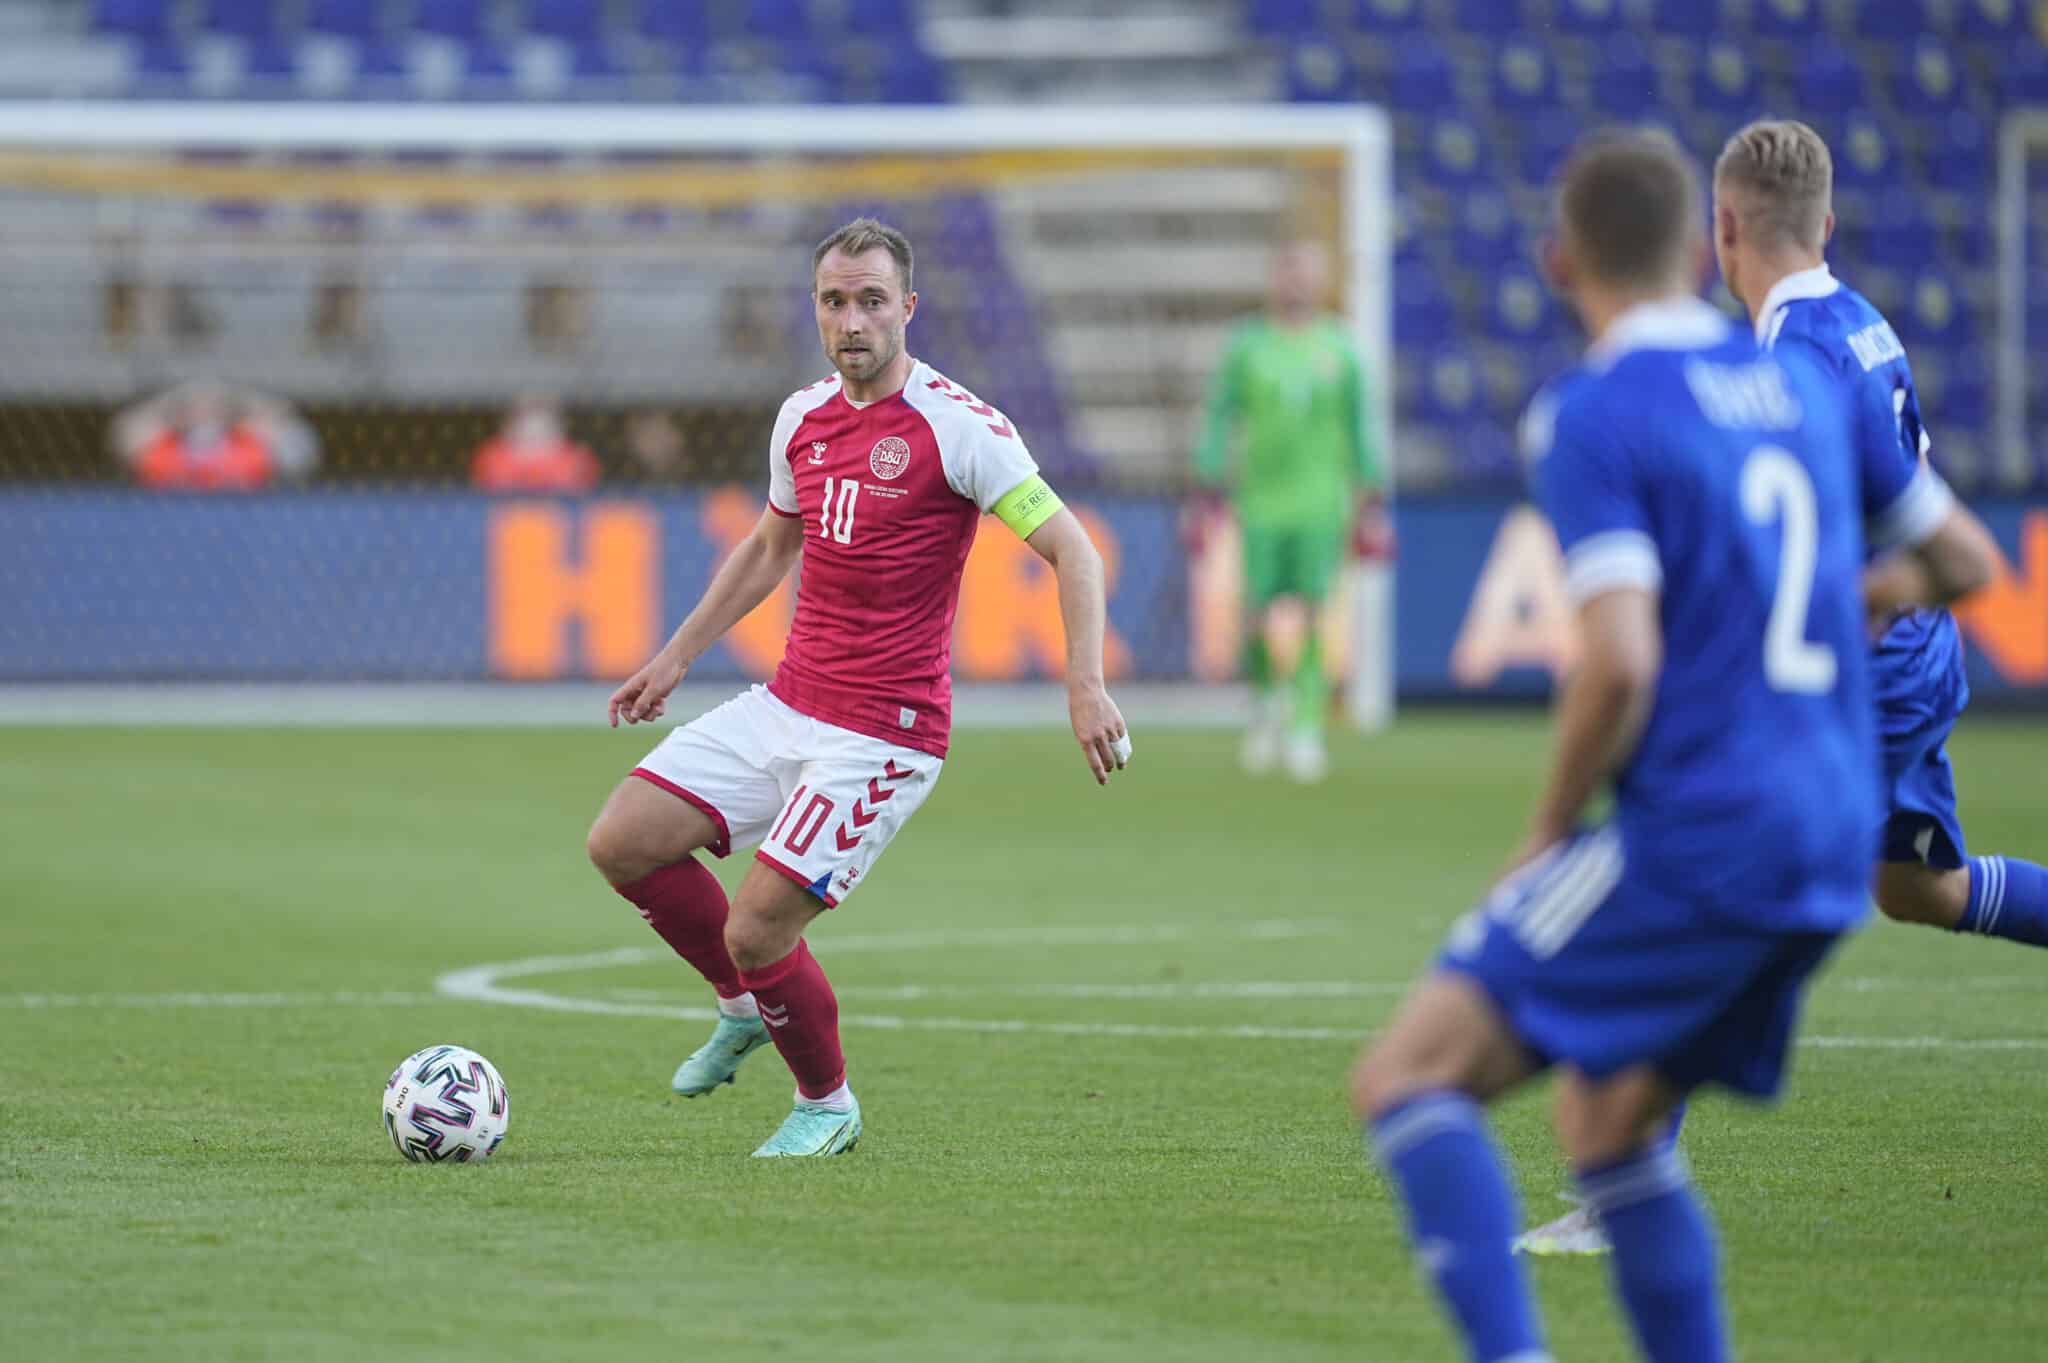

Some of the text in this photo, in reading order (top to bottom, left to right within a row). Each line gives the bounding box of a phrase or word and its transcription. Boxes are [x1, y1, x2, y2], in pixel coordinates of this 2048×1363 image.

[880, 450, 902, 465] DBU
[820, 477, 859, 544] 10
[1740, 447, 1837, 694] 2
[771, 785, 834, 856] 10
